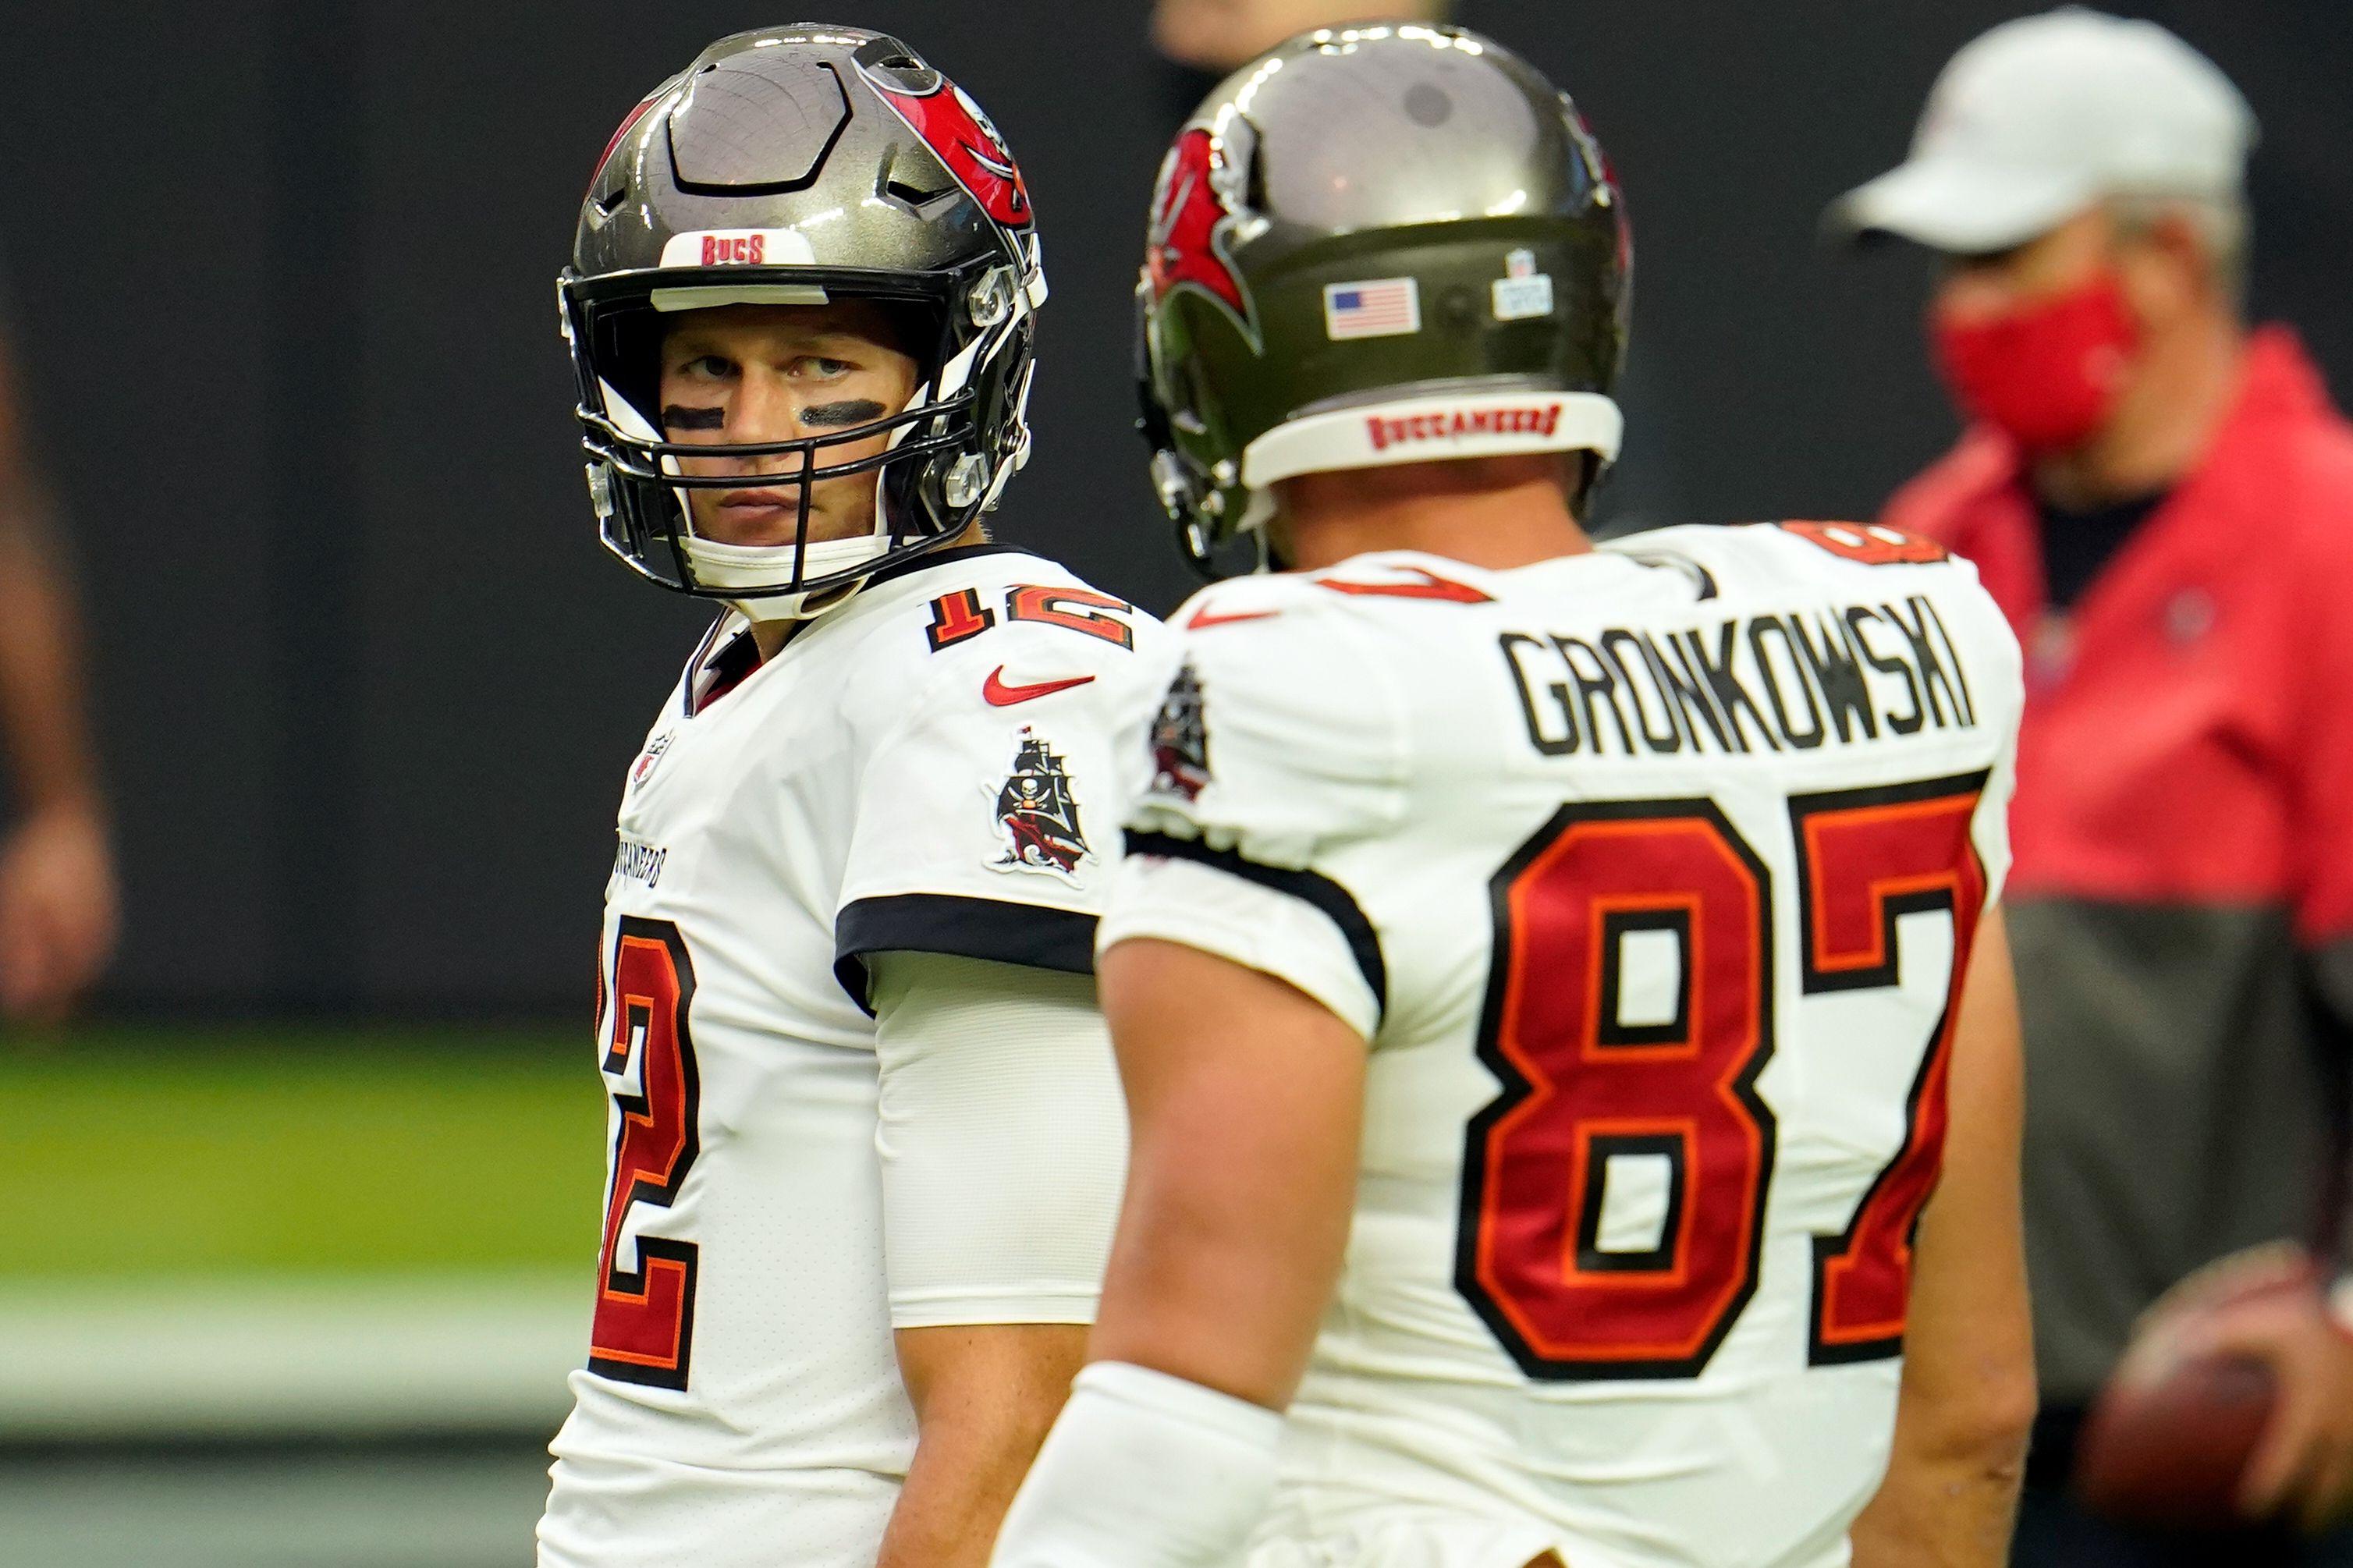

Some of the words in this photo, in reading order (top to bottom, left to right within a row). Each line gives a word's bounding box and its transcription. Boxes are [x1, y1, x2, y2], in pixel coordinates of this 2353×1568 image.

[1367, 404, 1560, 450] BUCCANEERS
[925, 584, 1134, 653] 12
[1499, 596, 1975, 757] GRONKOWSKI
[588, 914, 700, 1392] 2
[1454, 768, 1993, 1381] 87
